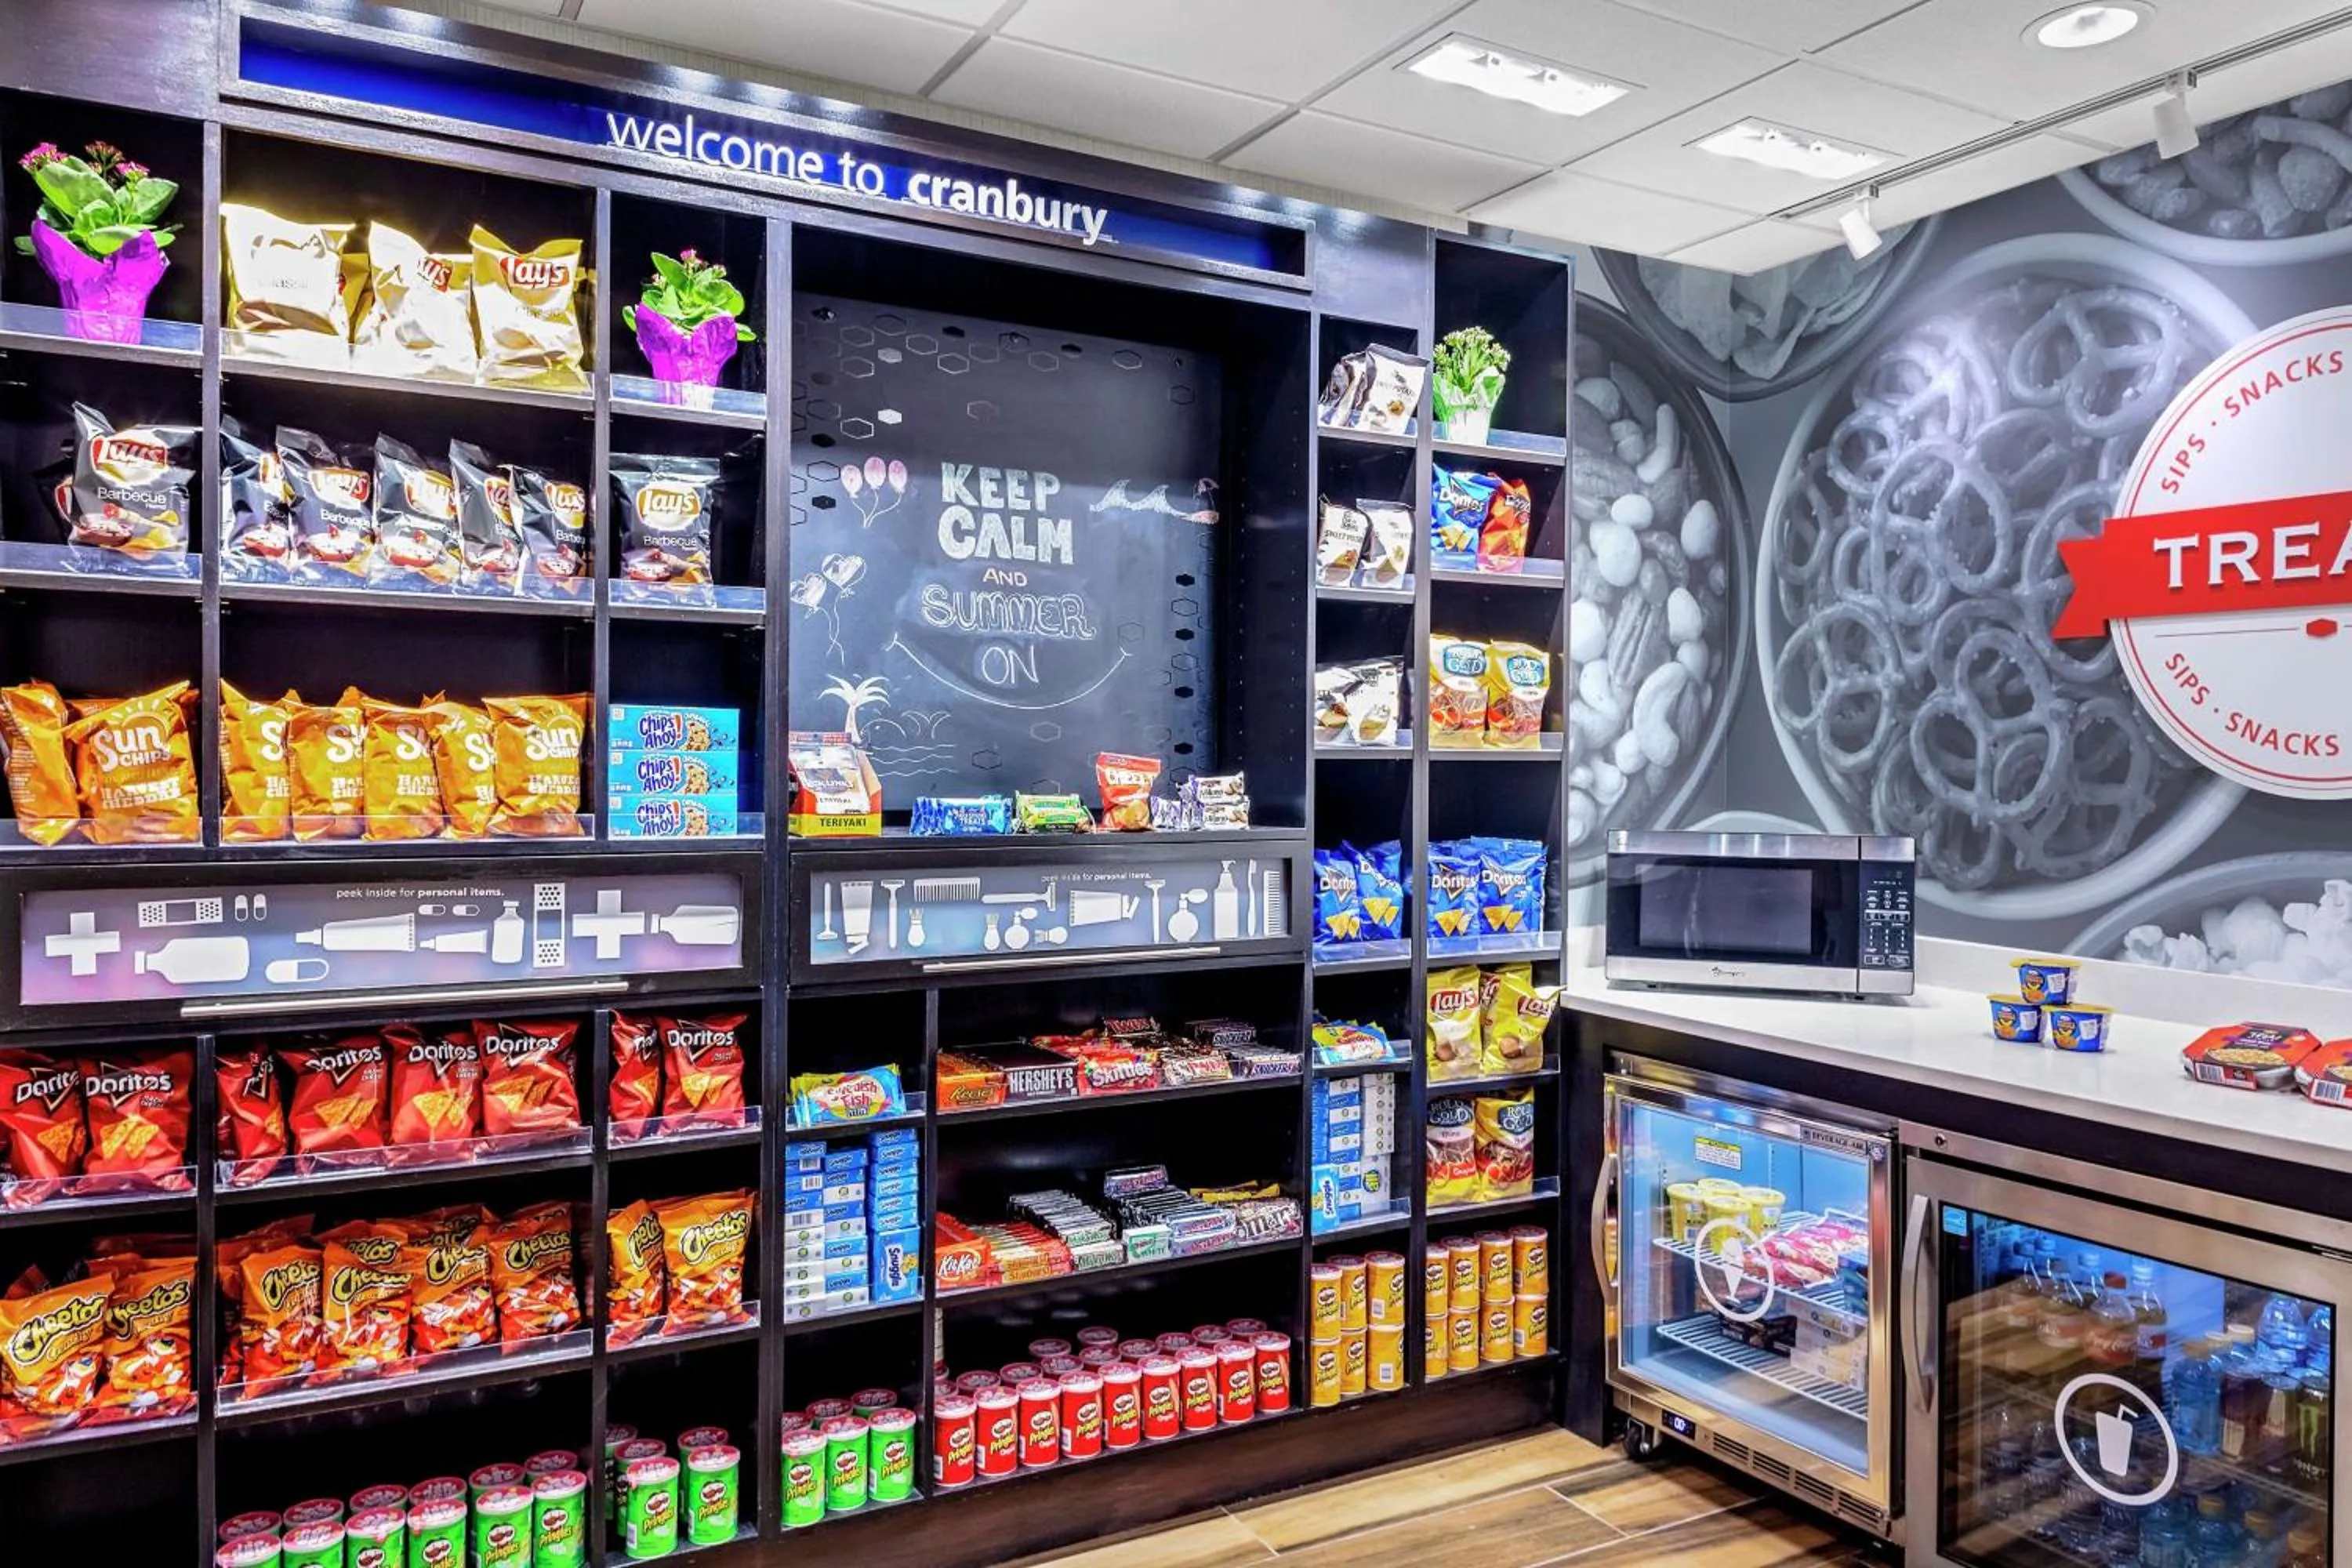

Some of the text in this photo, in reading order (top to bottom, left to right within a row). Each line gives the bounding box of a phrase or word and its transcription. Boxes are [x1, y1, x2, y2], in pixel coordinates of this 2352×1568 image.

[607, 112, 1107, 245] welcome to cranbury
[2161, 350, 2344, 494] SIPS SNACKS
[97, 487, 167, 504] Barbecue
[942, 462, 1060, 512] KEEP
[644, 535, 697, 546] Barbecue
[938, 505, 1073, 564] CALM
[982, 568, 1028, 587] AND
[922, 584, 1097, 640] SUMMER
[982, 644, 1041, 685] ON
[2165, 653, 2340, 757] SIPS SNACKS
[639, 716, 675, 735] Chips
[93, 726, 165, 772] Sun
[525, 726, 579, 760] Sun
[119, 747, 170, 766] CHIPS
[637, 760, 673, 779] Chips
[637, 803, 673, 822] Chips
[819, 818, 866, 827] TERIYAKI
[1094, 872, 1127, 881] personal
[336, 887, 505, 899] peek inside for personal items.
[485, 1036, 559, 1054] Doritos
[667, 1029, 735, 1047] Doritos
[408, 1044, 477, 1062] Doritos
[86, 1073, 172, 1097] Doritos
[1092, 1061, 1154, 1087] Skittles
[683, 1213, 746, 1262] Cheetos
[888, 1247, 902, 1287] Snuggle
[833, 1467, 862, 1486] Pringles
[881, 1456, 911, 1477] Pringles
[786, 1480, 818, 1504] Pringles
[699, 1497, 729, 1522] Pringles
[642, 1508, 674, 1534] Pringles
[539, 1525, 574, 1546] Pringles
[485, 1541, 520, 1563] Pringles
